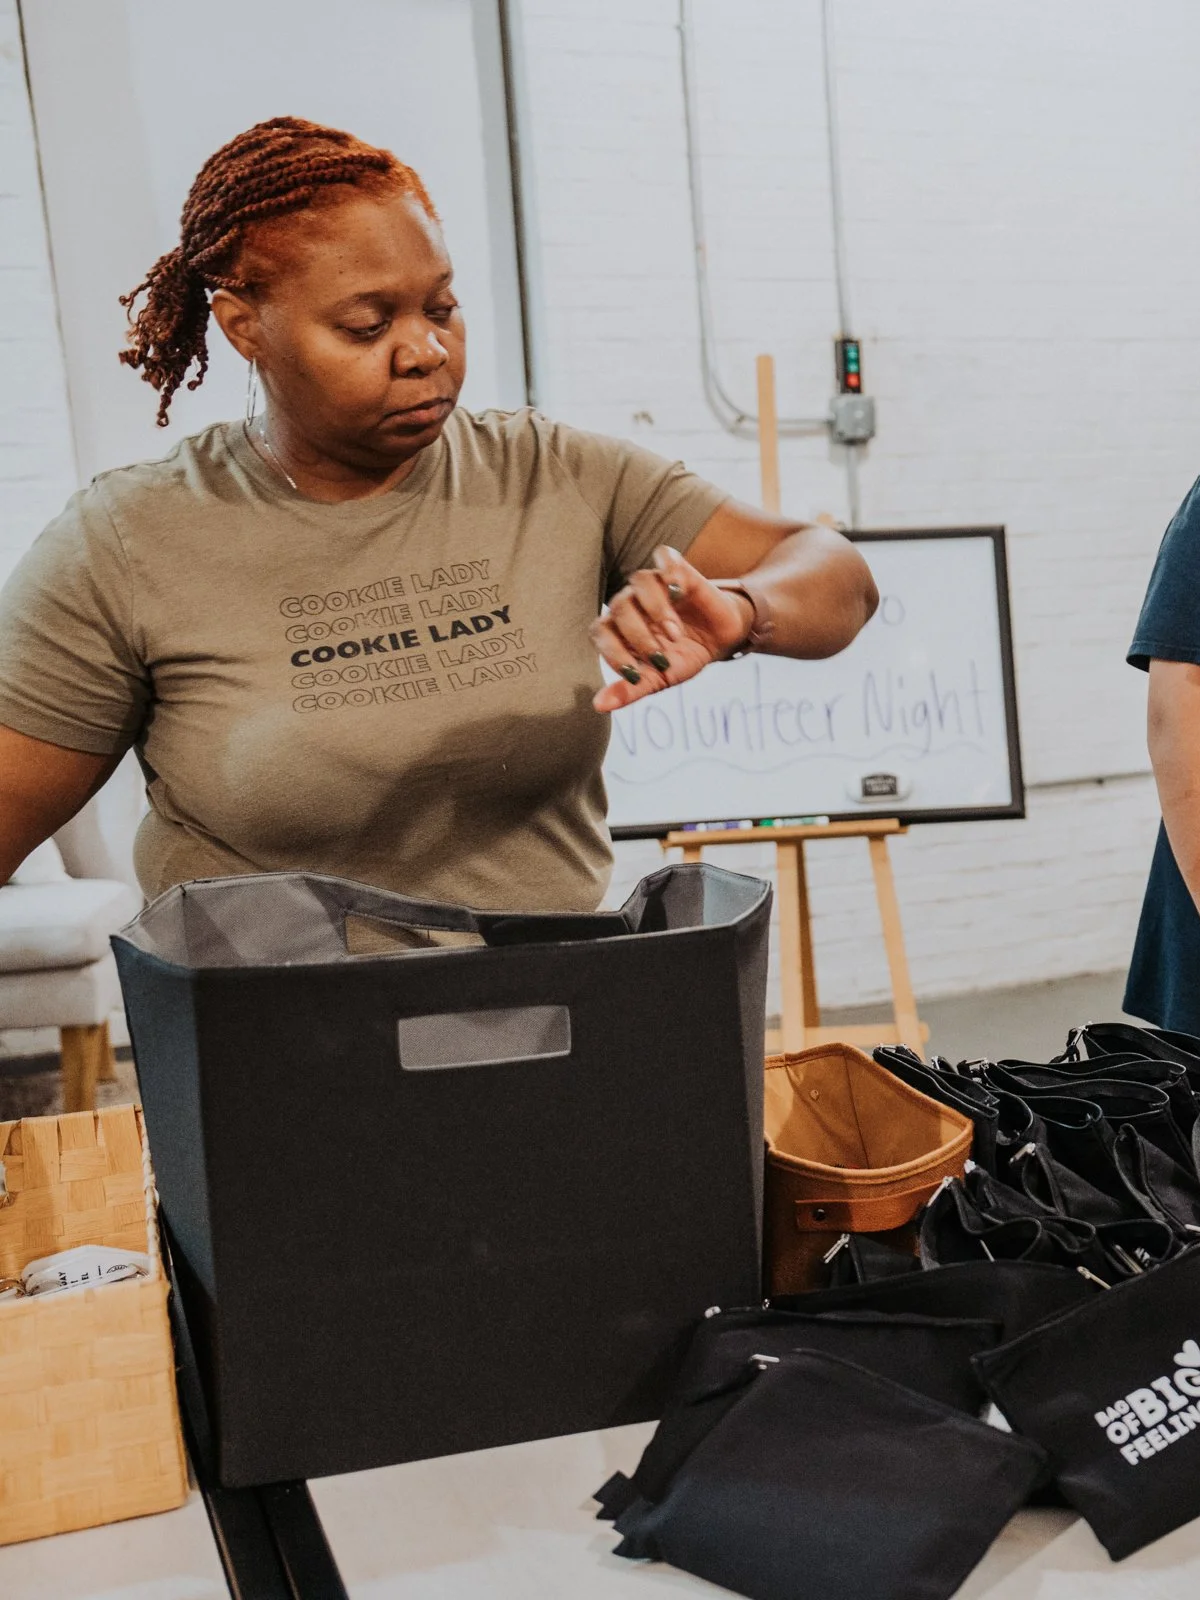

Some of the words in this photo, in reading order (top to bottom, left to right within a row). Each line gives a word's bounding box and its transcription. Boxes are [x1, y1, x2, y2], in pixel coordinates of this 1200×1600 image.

[279, 576, 404, 619] COOKIE
[410, 559, 490, 594] LADY
[285, 604, 413, 643] COOKIE
[419, 584, 501, 619] LADY
[291, 630, 421, 668] COOKIE
[428, 605, 512, 643] LADY
[291, 654, 432, 689] COOKIE
[437, 628, 526, 668] LADY
[292, 678, 441, 714] COOKIE
[448, 653, 539, 691] LADY
[864, 660, 990, 753] Night
[1094, 1399, 1130, 1428] BAG
[1106, 1413, 1142, 1445] OF
